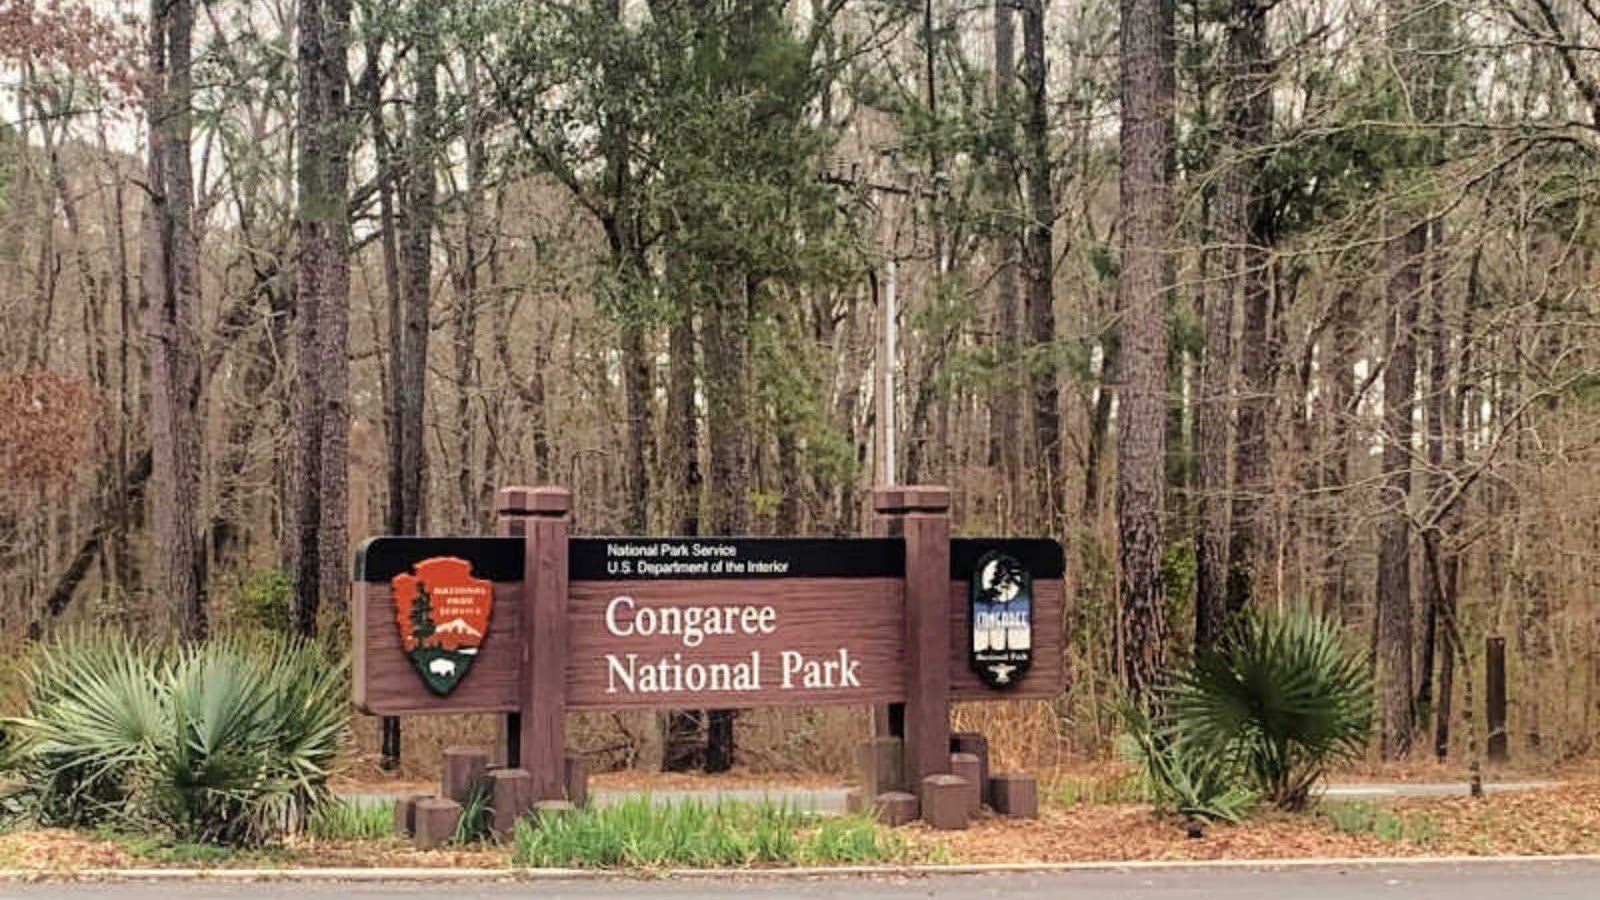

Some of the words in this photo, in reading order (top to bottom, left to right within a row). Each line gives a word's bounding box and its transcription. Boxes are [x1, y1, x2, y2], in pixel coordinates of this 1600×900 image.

[607, 543, 657, 556] National
[661, 543, 688, 556] Park
[692, 543, 736, 556] Service
[607, 561, 632, 573] U.S.
[638, 561, 708, 575] Department
[711, 561, 722, 573] of
[726, 561, 744, 573] the
[748, 560, 789, 573] Interior
[605, 596, 776, 647] Congaree
[606, 652, 760, 693] National
[781, 648, 861, 689] Park
